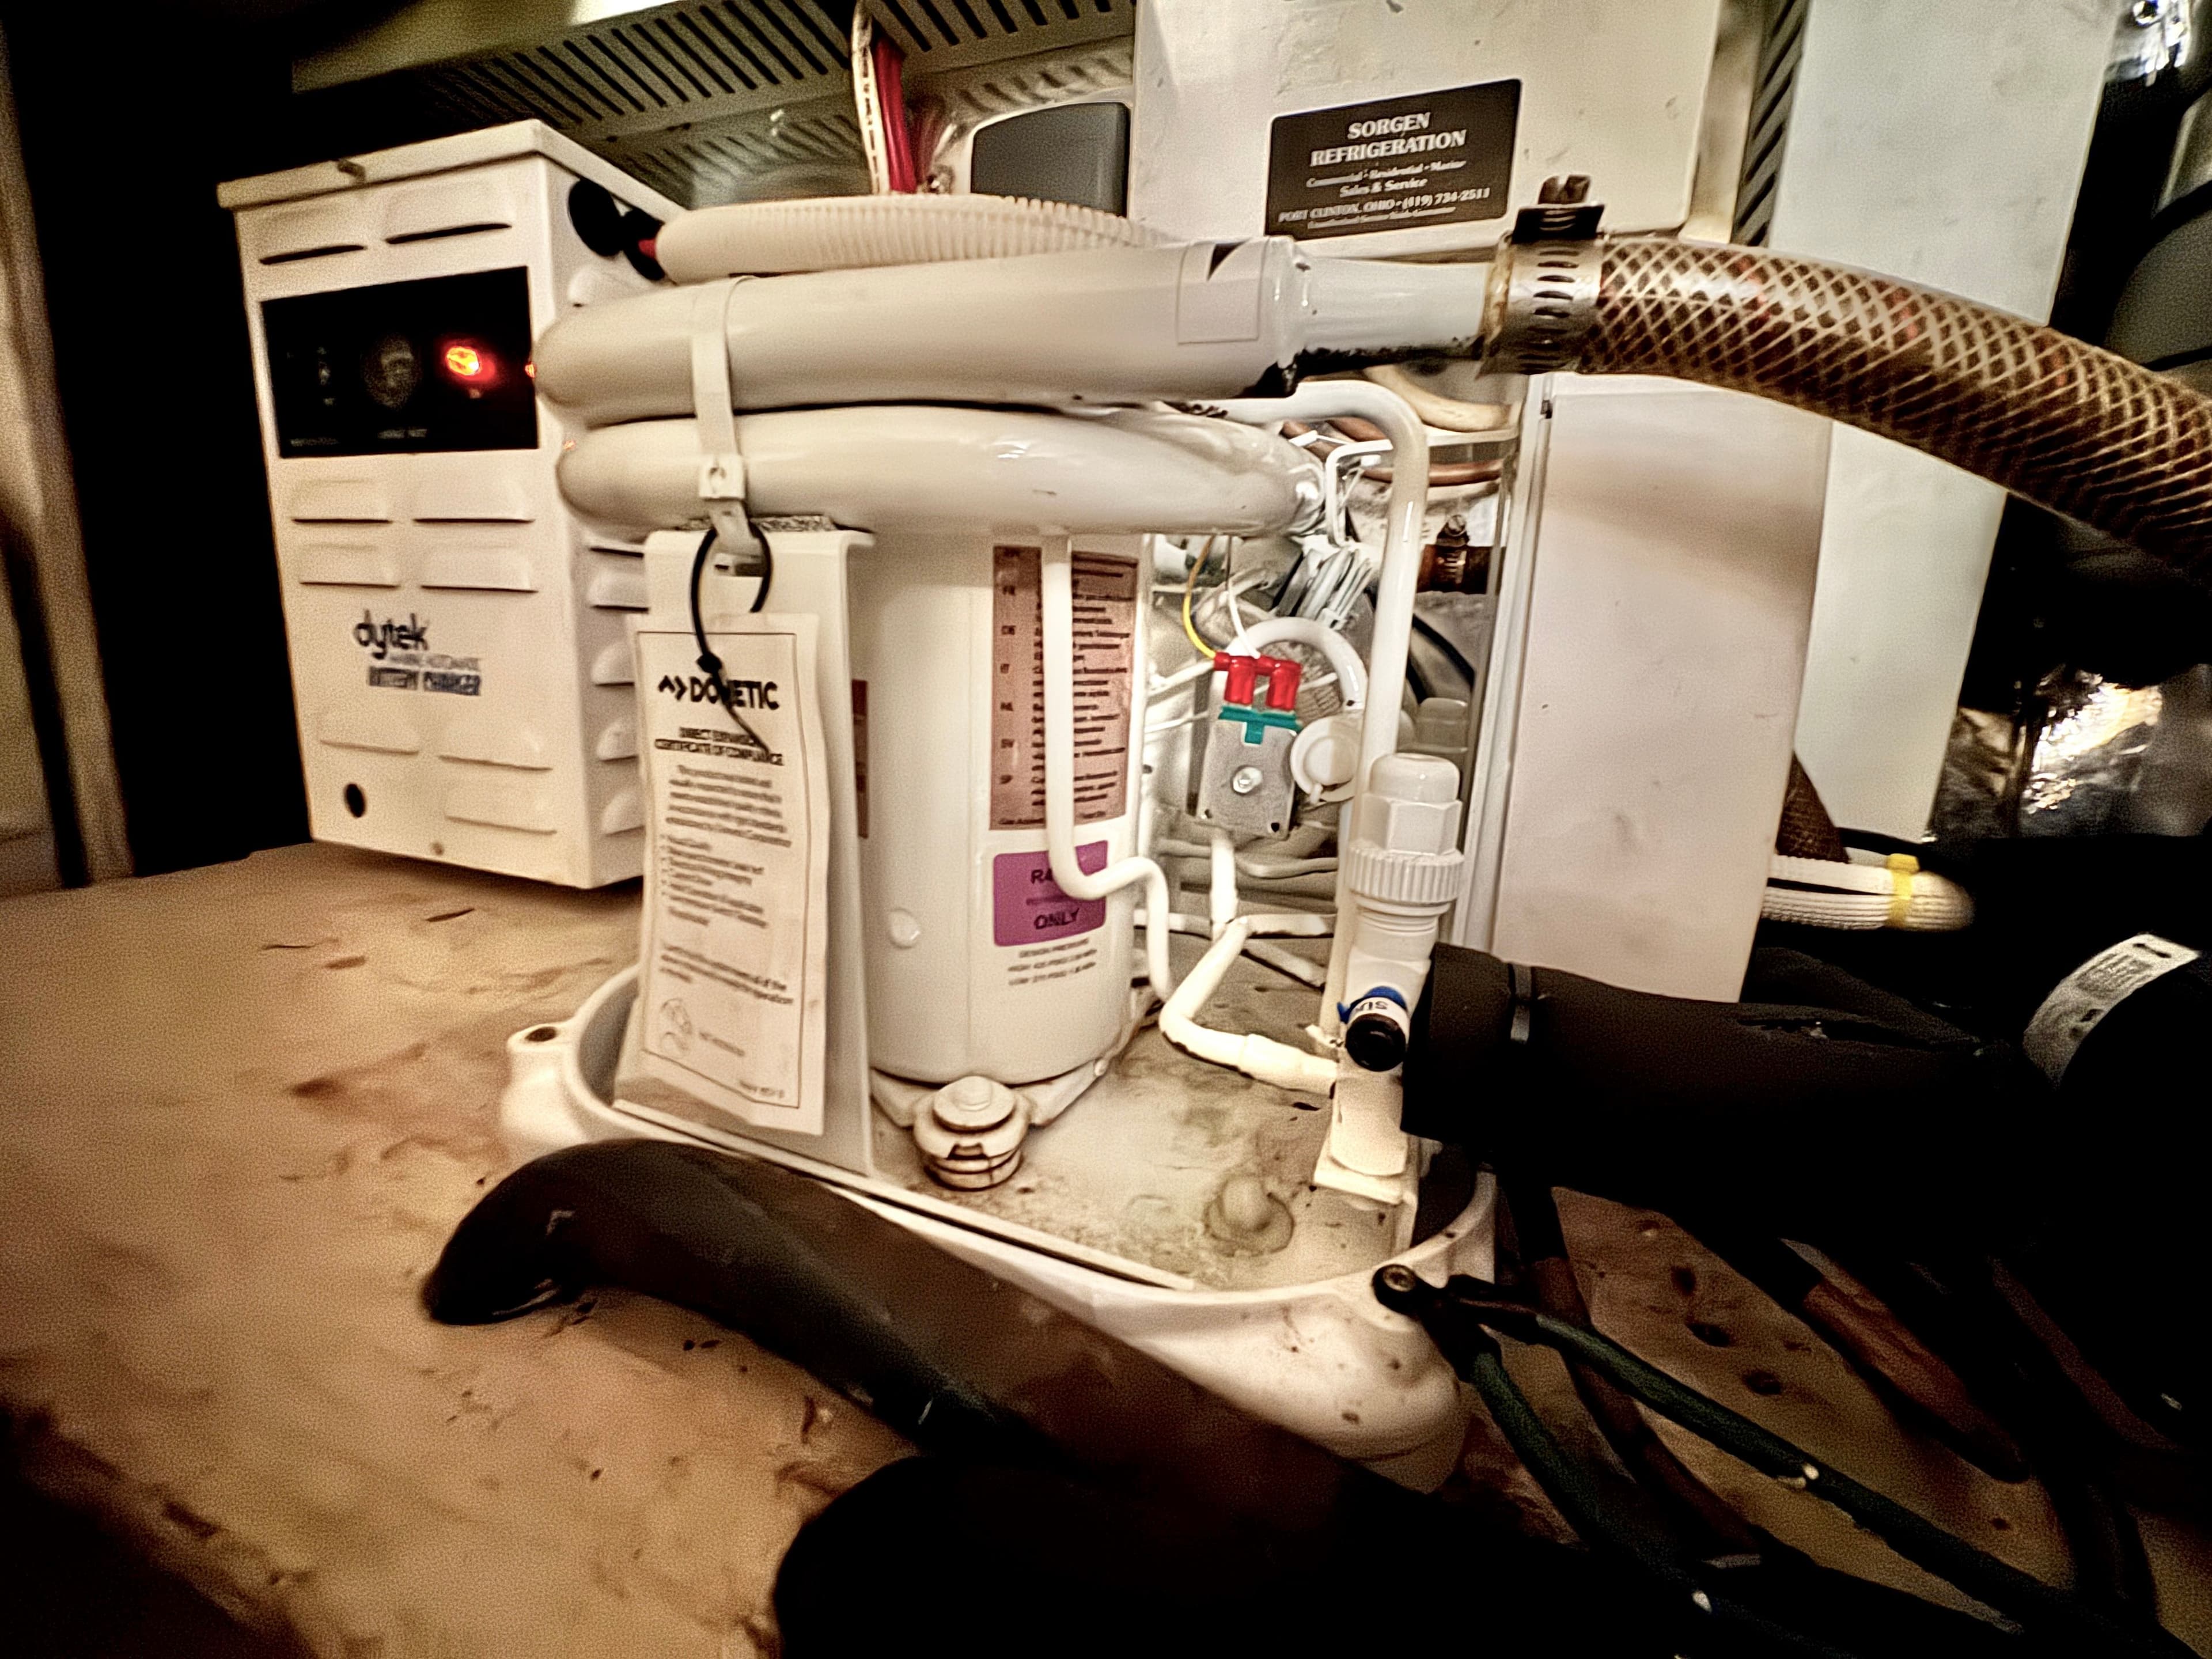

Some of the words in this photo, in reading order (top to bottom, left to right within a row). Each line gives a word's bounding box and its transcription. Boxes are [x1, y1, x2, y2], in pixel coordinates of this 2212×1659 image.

[1347, 111, 1431, 139] SORGEN
[1309, 130, 1467, 167] REFRIGERATION
[1384, 177, 1429, 192] Service
[689, 676, 780, 711] DOETIC
[1033, 907, 1080, 930] ONLY
